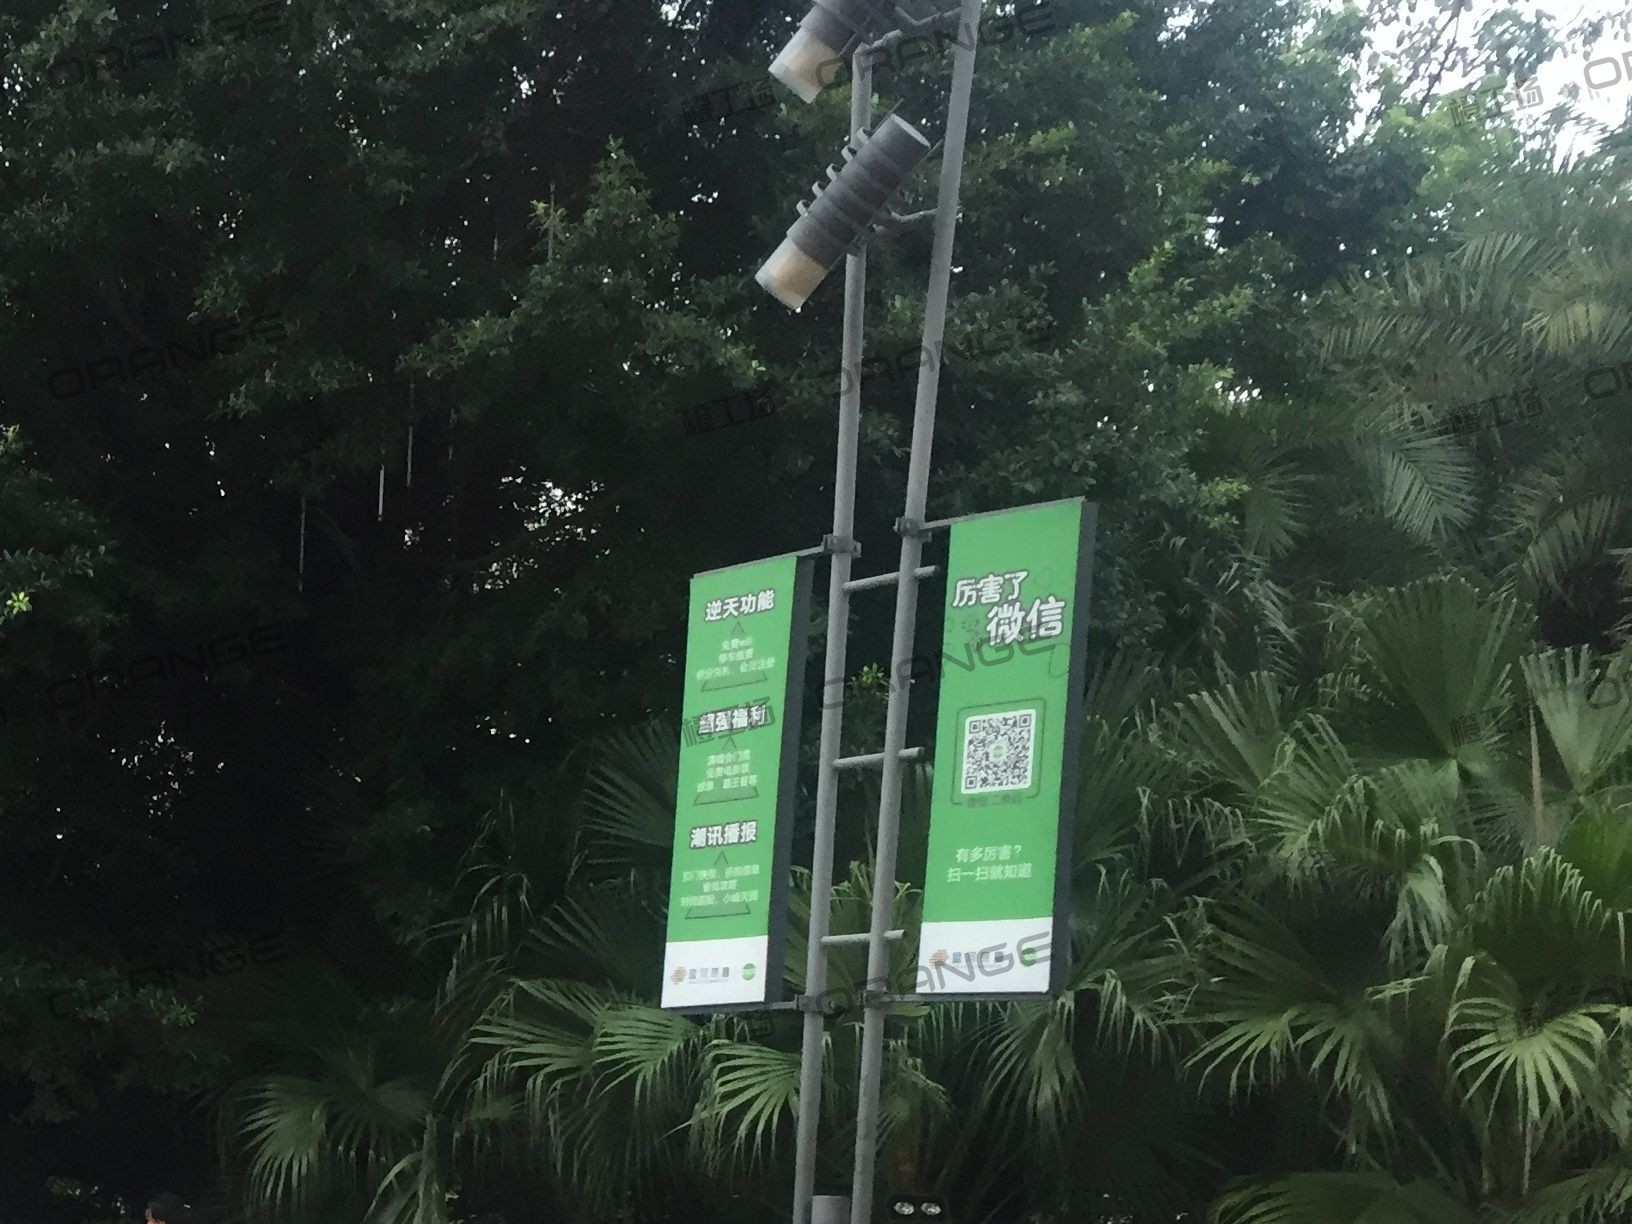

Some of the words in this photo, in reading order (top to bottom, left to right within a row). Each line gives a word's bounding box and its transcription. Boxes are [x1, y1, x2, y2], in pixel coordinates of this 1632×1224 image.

[952, 571, 1028, 607] 厉害了
[705, 589, 775, 621] 逆天功能
[986, 595, 1065, 646] 微信
[698, 705, 766, 734] 超强福利
[690, 821, 757, 848] 潮讯播报
[947, 863, 1033, 883] 扫一扫就知道
